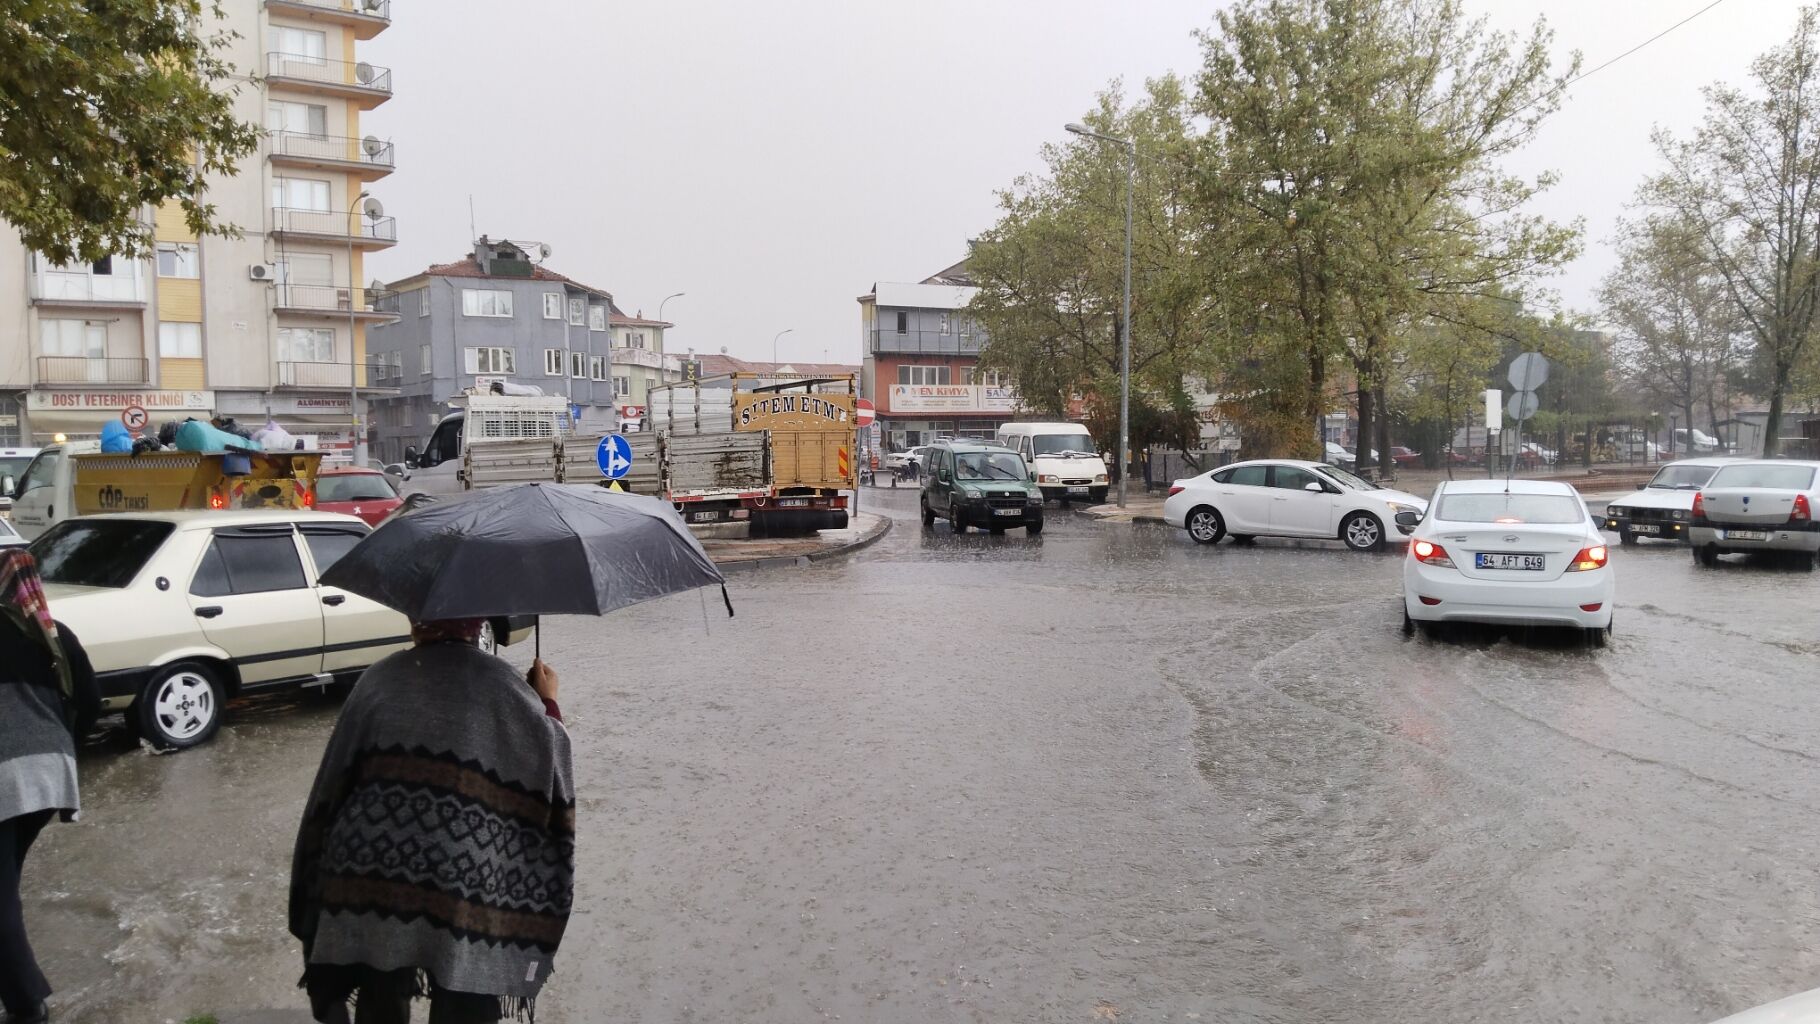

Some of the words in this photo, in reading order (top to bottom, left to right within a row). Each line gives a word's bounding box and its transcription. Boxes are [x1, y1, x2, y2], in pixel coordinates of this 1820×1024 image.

[52, 393, 81, 406] DOST
[84, 392, 143, 406] VETERİNER
[145, 391, 184, 406] KLİNİĞİ
[1483, 554, 1495, 565] 64
[1501, 555, 1519, 566] AFT
[1524, 556, 1542, 567] 649
